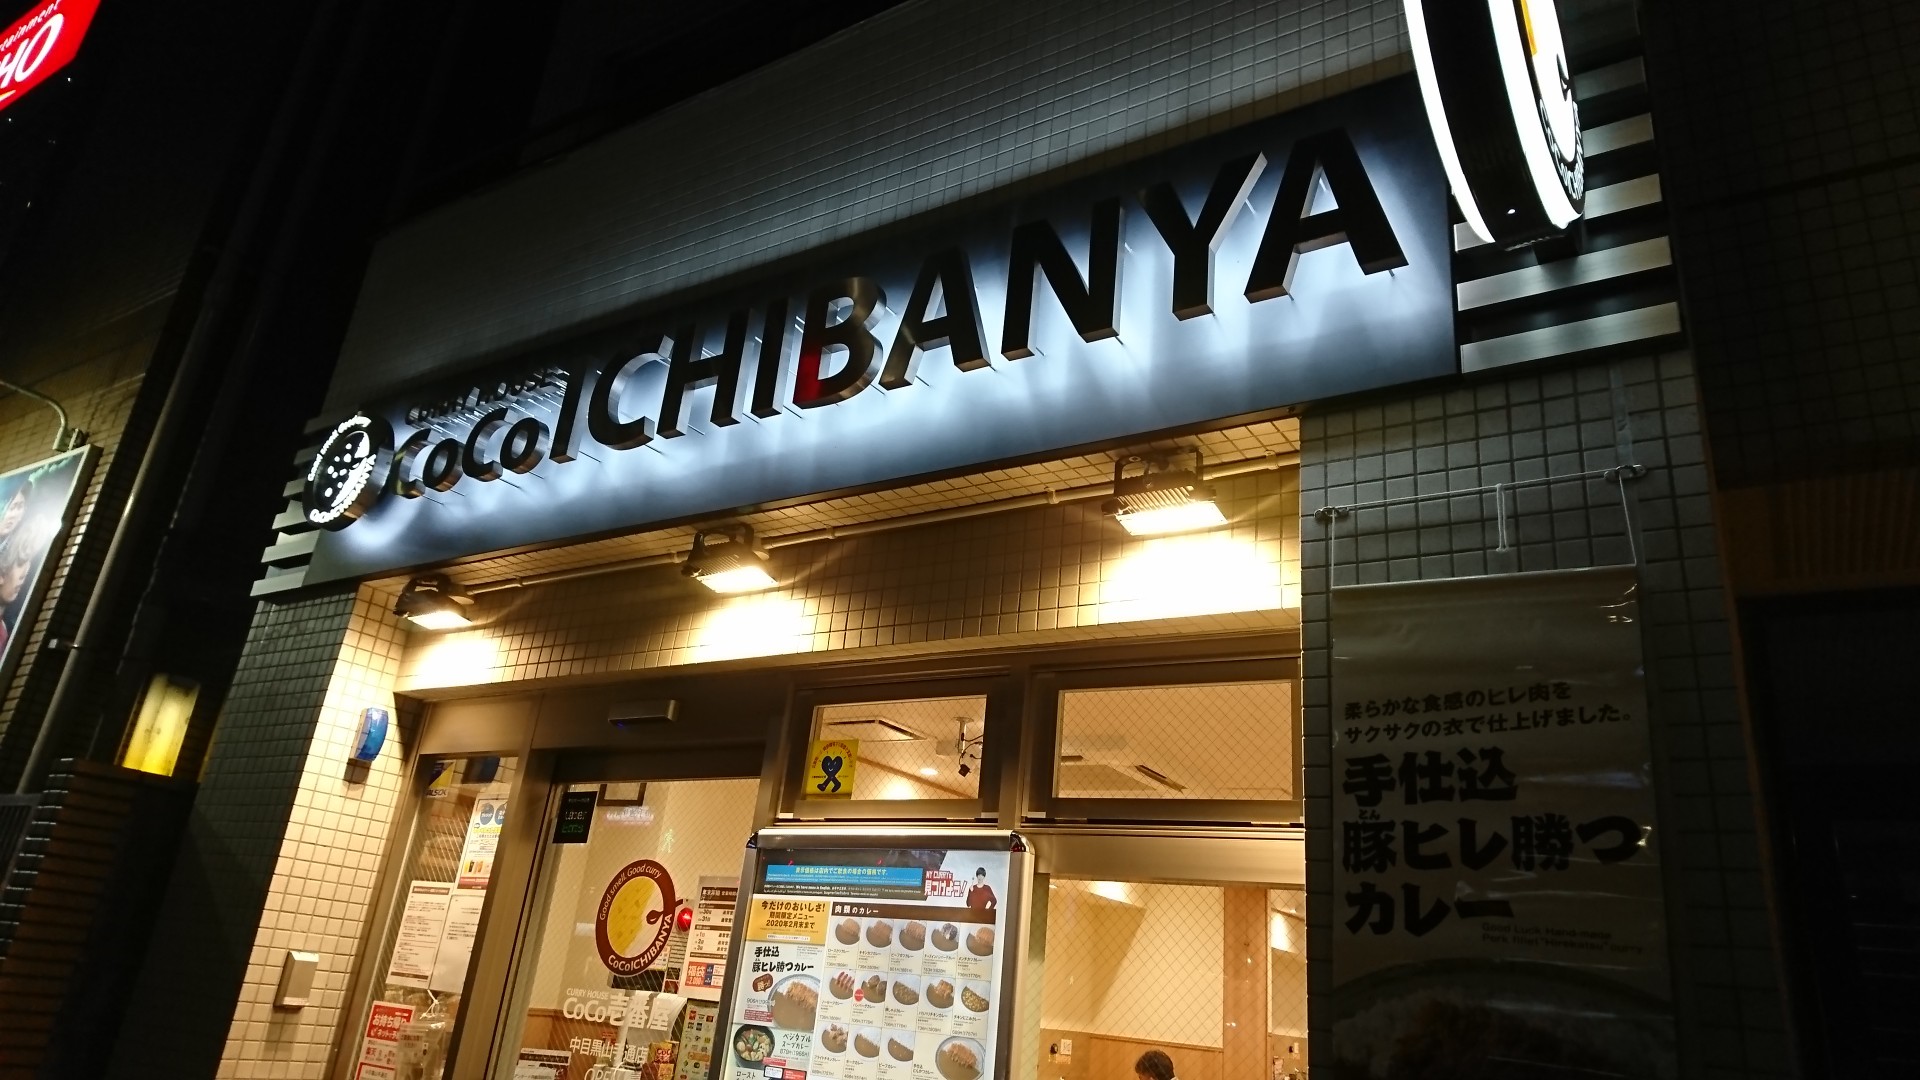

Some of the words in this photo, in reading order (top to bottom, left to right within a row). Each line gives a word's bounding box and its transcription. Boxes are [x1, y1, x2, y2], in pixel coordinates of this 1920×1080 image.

[1344, 682, 1571, 721] 柔らかな食感のヒレ肉を
[1344, 703, 1631, 744] サクサクの衣で仕上げました。
[1342, 746, 1518, 806] 手仕込
[1342, 812, 1642, 874] 豚ヒレ勝つ
[599, 892, 613, 921] Good
[626, 864, 646, 878] Good
[645, 864, 663, 879] curry
[761, 901, 826, 912] 今だけのおいしさ!
[769, 911, 815, 920] 期間限定メニュー
[1344, 881, 1514, 937] カレー
[766, 919, 815, 930] 2020年2月末まで
[1482, 922, 1511, 932] Good
[1514, 924, 1541, 934] Luck
[1482, 934, 1508, 943] Pork
[608, 913, 673, 972] CoCoICHIBANYA
[754, 946, 780, 958] 手仕込
[751, 961, 815, 973] 豚ヒレ勝つカレー
[566, 987, 588, 997] CURRY
[587, 989, 610, 1000] HOUSE
[562, 992, 669, 1031] CoCo壱番屋
[570, 1036, 648, 1064] 中目黒山手通店
